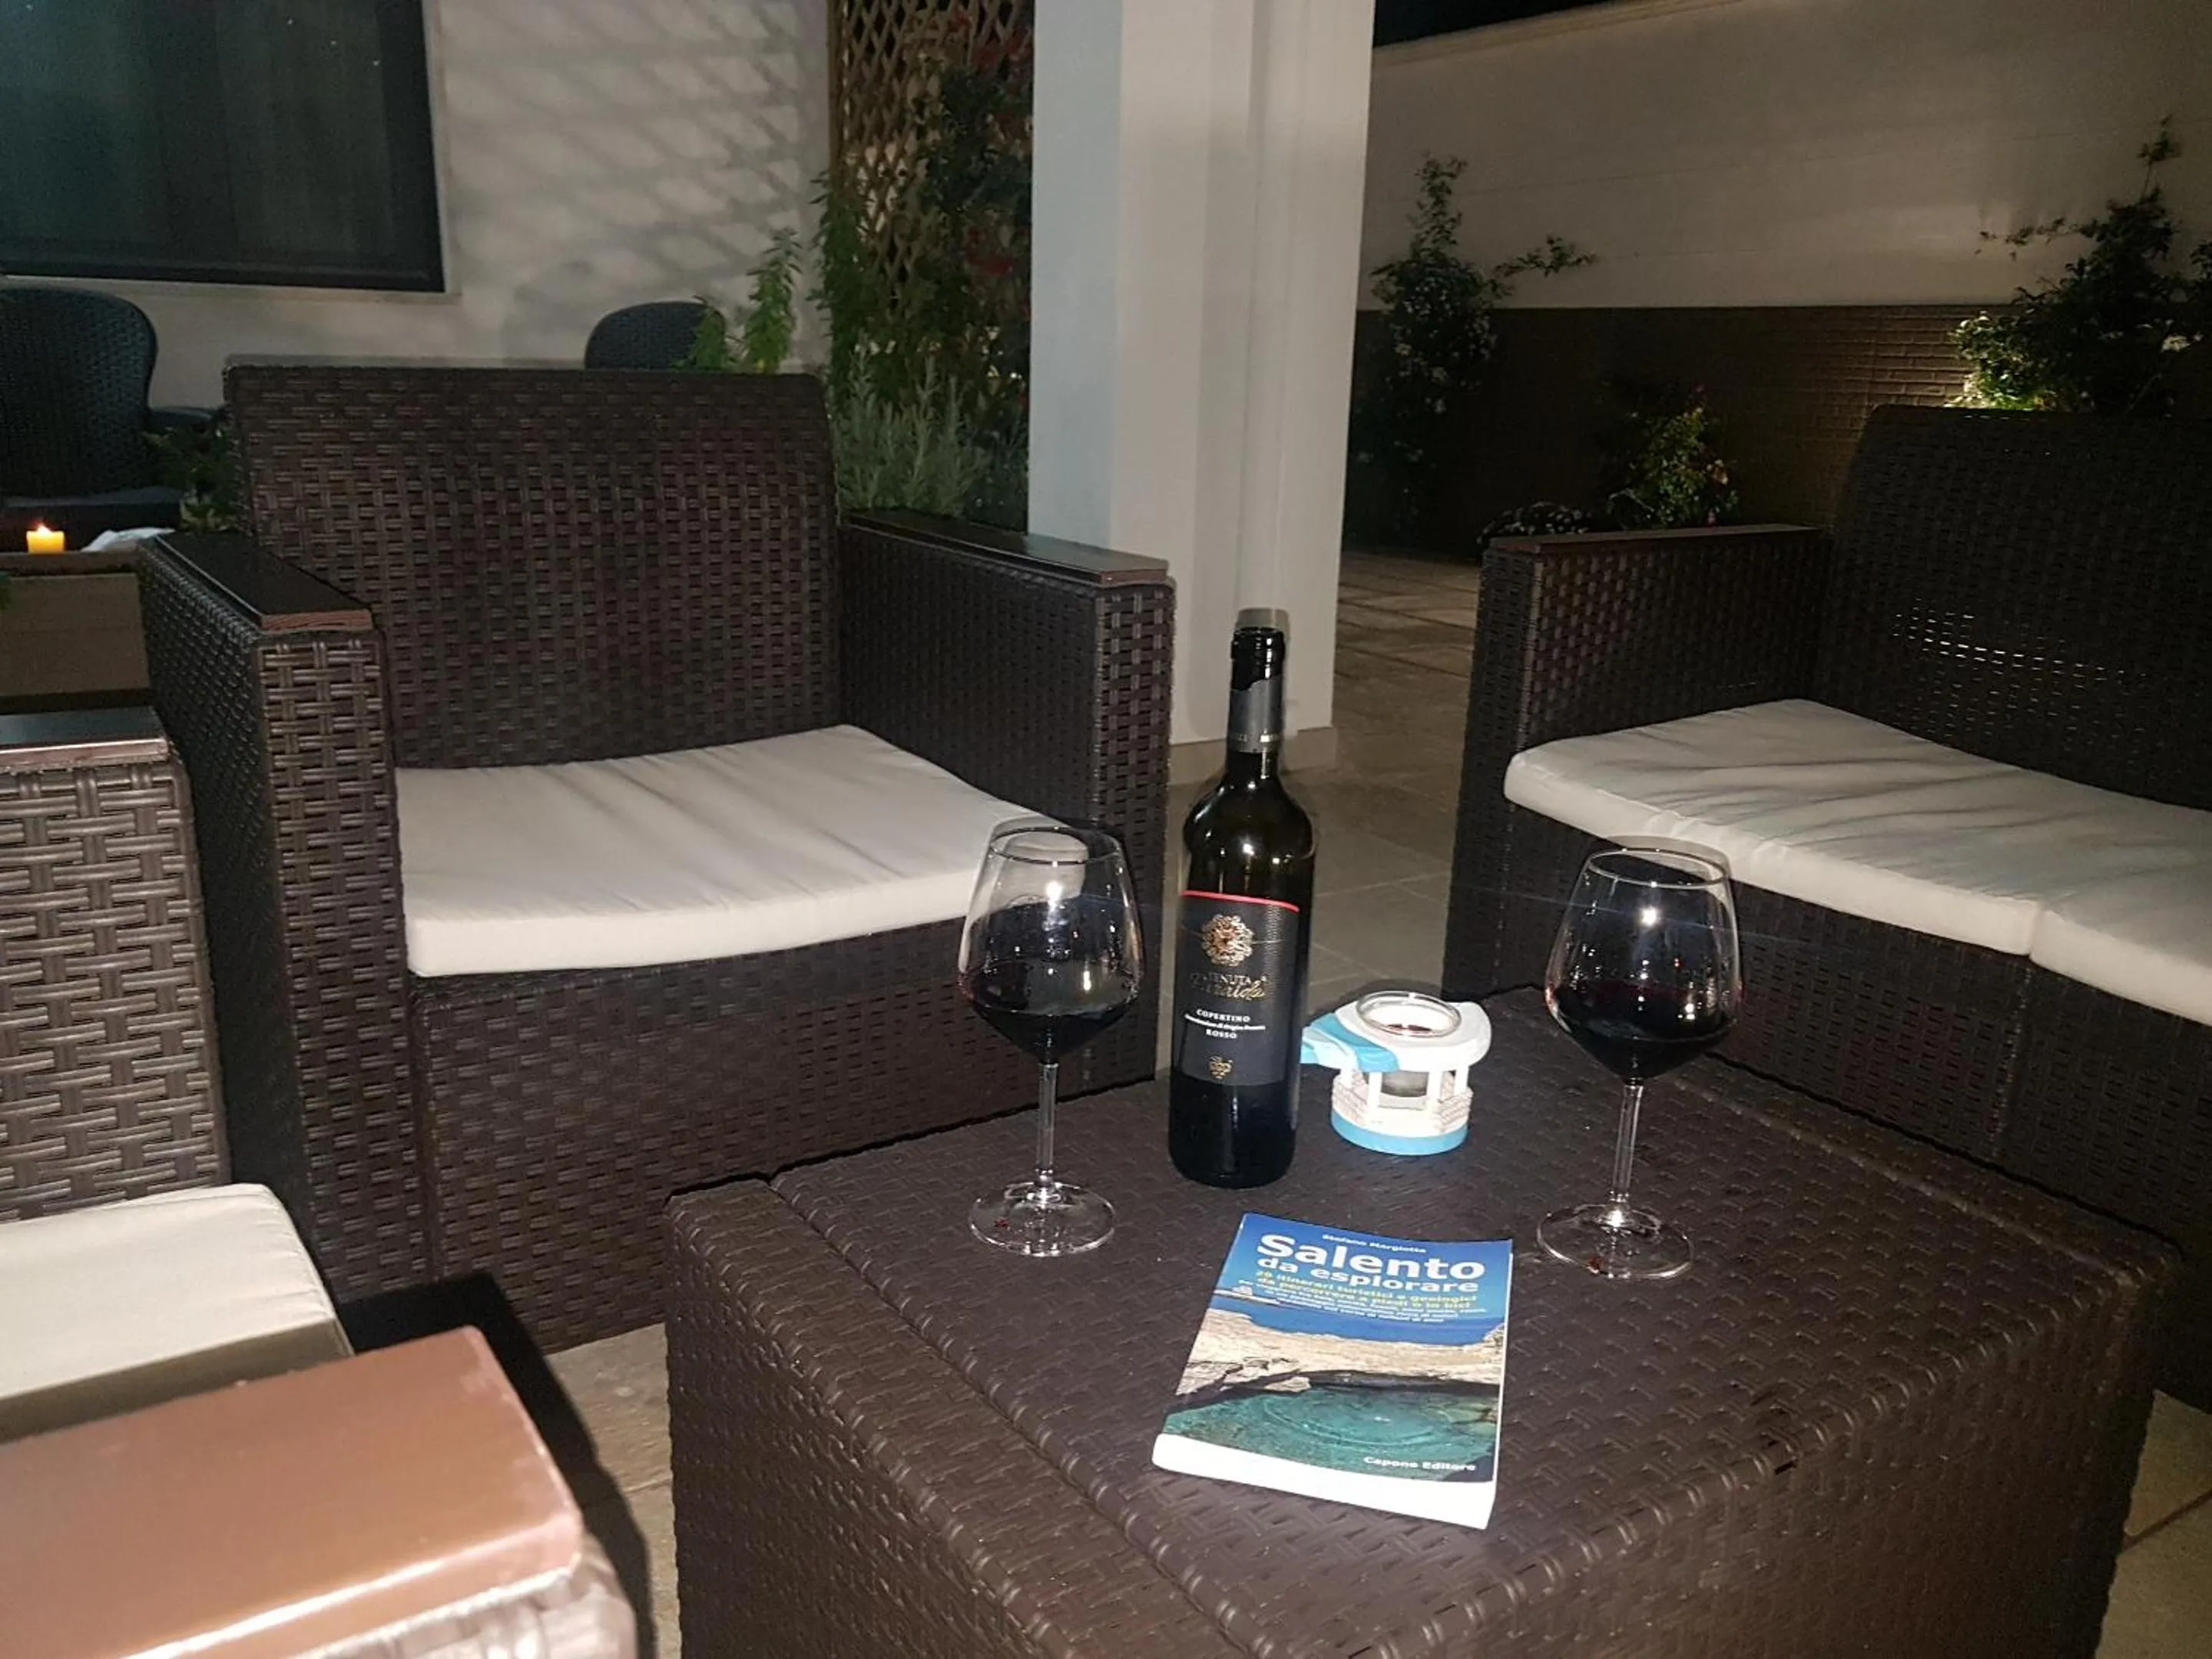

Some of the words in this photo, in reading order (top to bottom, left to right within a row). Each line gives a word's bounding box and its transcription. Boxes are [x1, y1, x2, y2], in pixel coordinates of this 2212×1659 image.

[1196, 1008, 1250, 1023] COPERTINO
[1205, 1028, 1237, 1039] ROSSO
[1322, 1233, 1366, 1246] Stefano
[1257, 1234, 1485, 1280] Salento
[1257, 1257, 1298, 1273] da
[1310, 1268, 1479, 1293] esplorare
[1363, 1456, 1419, 1468] Capone
[1422, 1462, 1476, 1471] Editore
